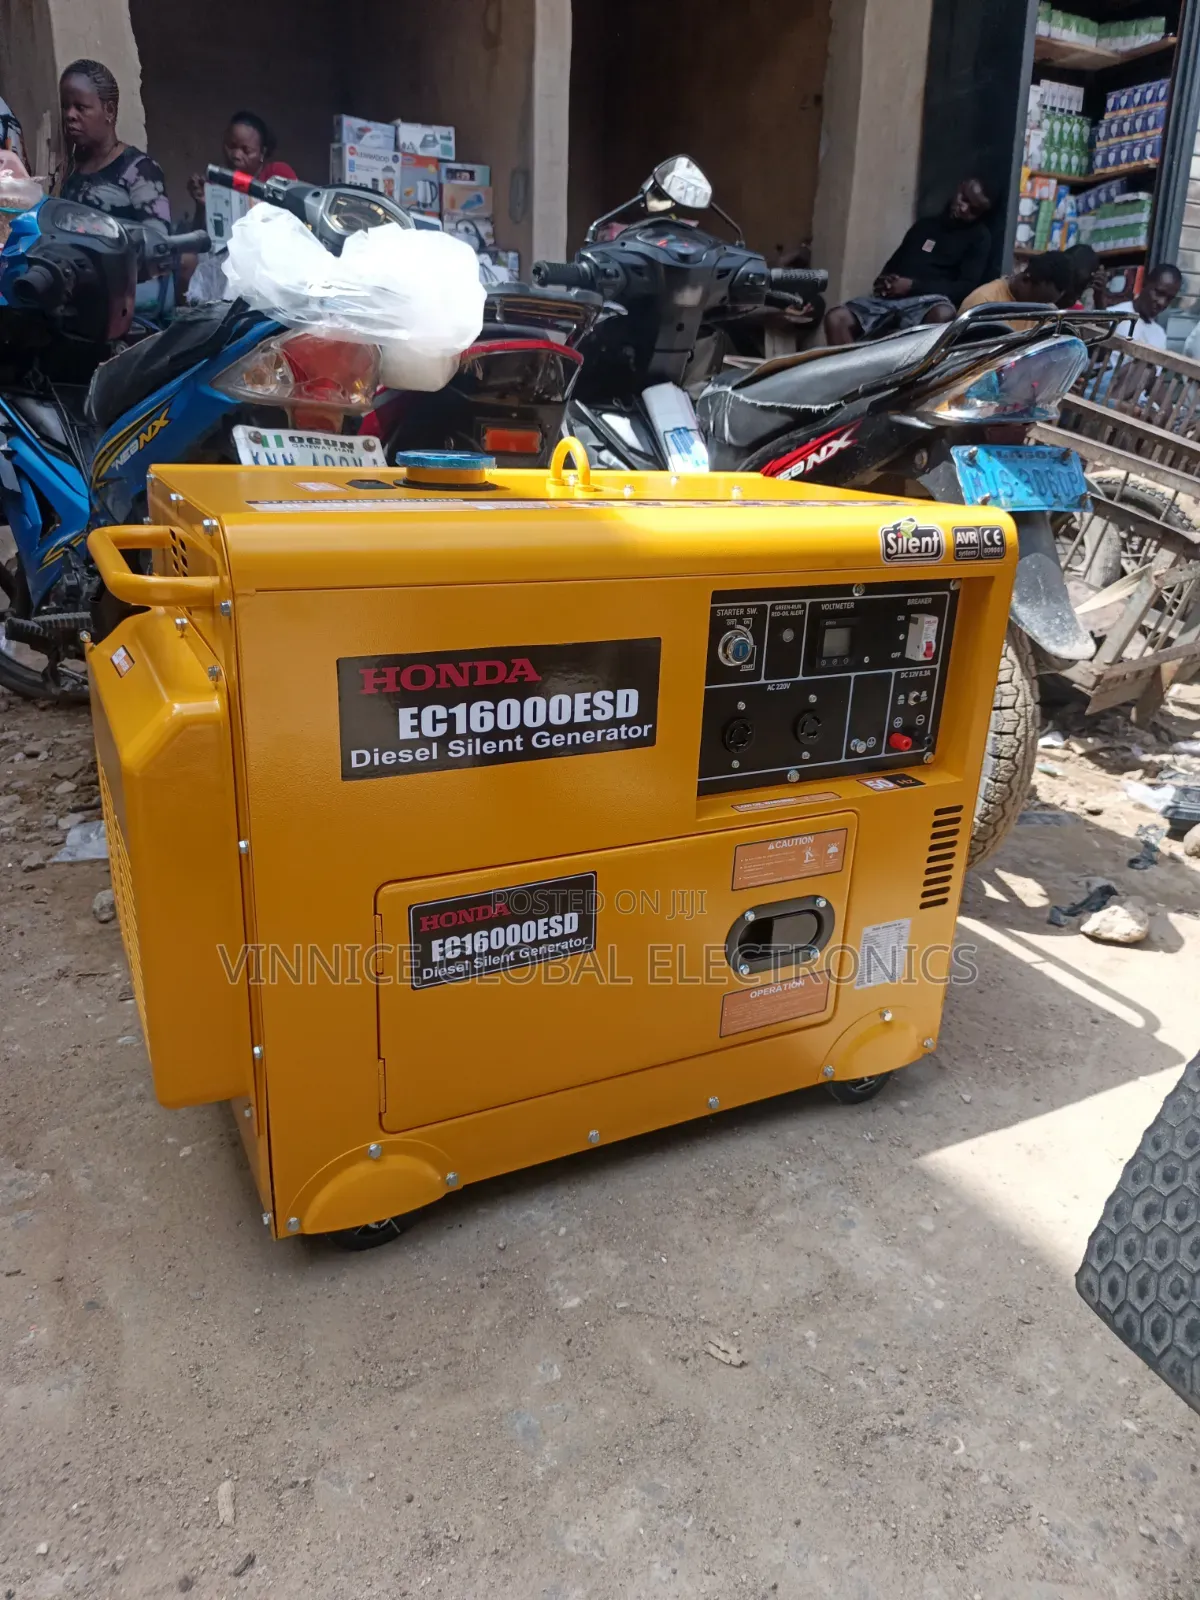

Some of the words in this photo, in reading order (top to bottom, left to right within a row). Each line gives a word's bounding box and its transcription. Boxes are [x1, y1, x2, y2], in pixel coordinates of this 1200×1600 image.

[288, 435, 355, 450] OGUN
[291, 443, 332, 451] GATEWAY
[333, 446, 354, 454] STATE
[886, 531, 940, 555] Silent
[956, 531, 978, 545] AVR
[983, 529, 1002, 546] CE
[821, 601, 855, 611] VOLTMETER
[907, 597, 932, 606] BREAKER
[716, 608, 744, 617] STARTER
[746, 607, 758, 615] SW.
[891, 651, 901, 659] OFF
[358, 657, 542, 695] HONDA
[900, 671, 909, 679] DC
[909, 670, 919, 678] 12V
[775, 682, 791, 691] 220V
[398, 688, 639, 740] EC16000ESD
[351, 741, 438, 768] Diesel
[447, 735, 524, 759] Silent
[531, 723, 653, 749] Generator
[864, 777, 895, 790] 50
[896, 777, 915, 786] Hz
[775, 835, 815, 849] CAUTION
[419, 903, 512, 932] HONDA
[431, 911, 579, 963] EC16000ESD
[422, 960, 469, 980] Diesel
[473, 950, 515, 969] Silent
[519, 936, 588, 958] Generator
[749, 979, 805, 999] OPERATION
